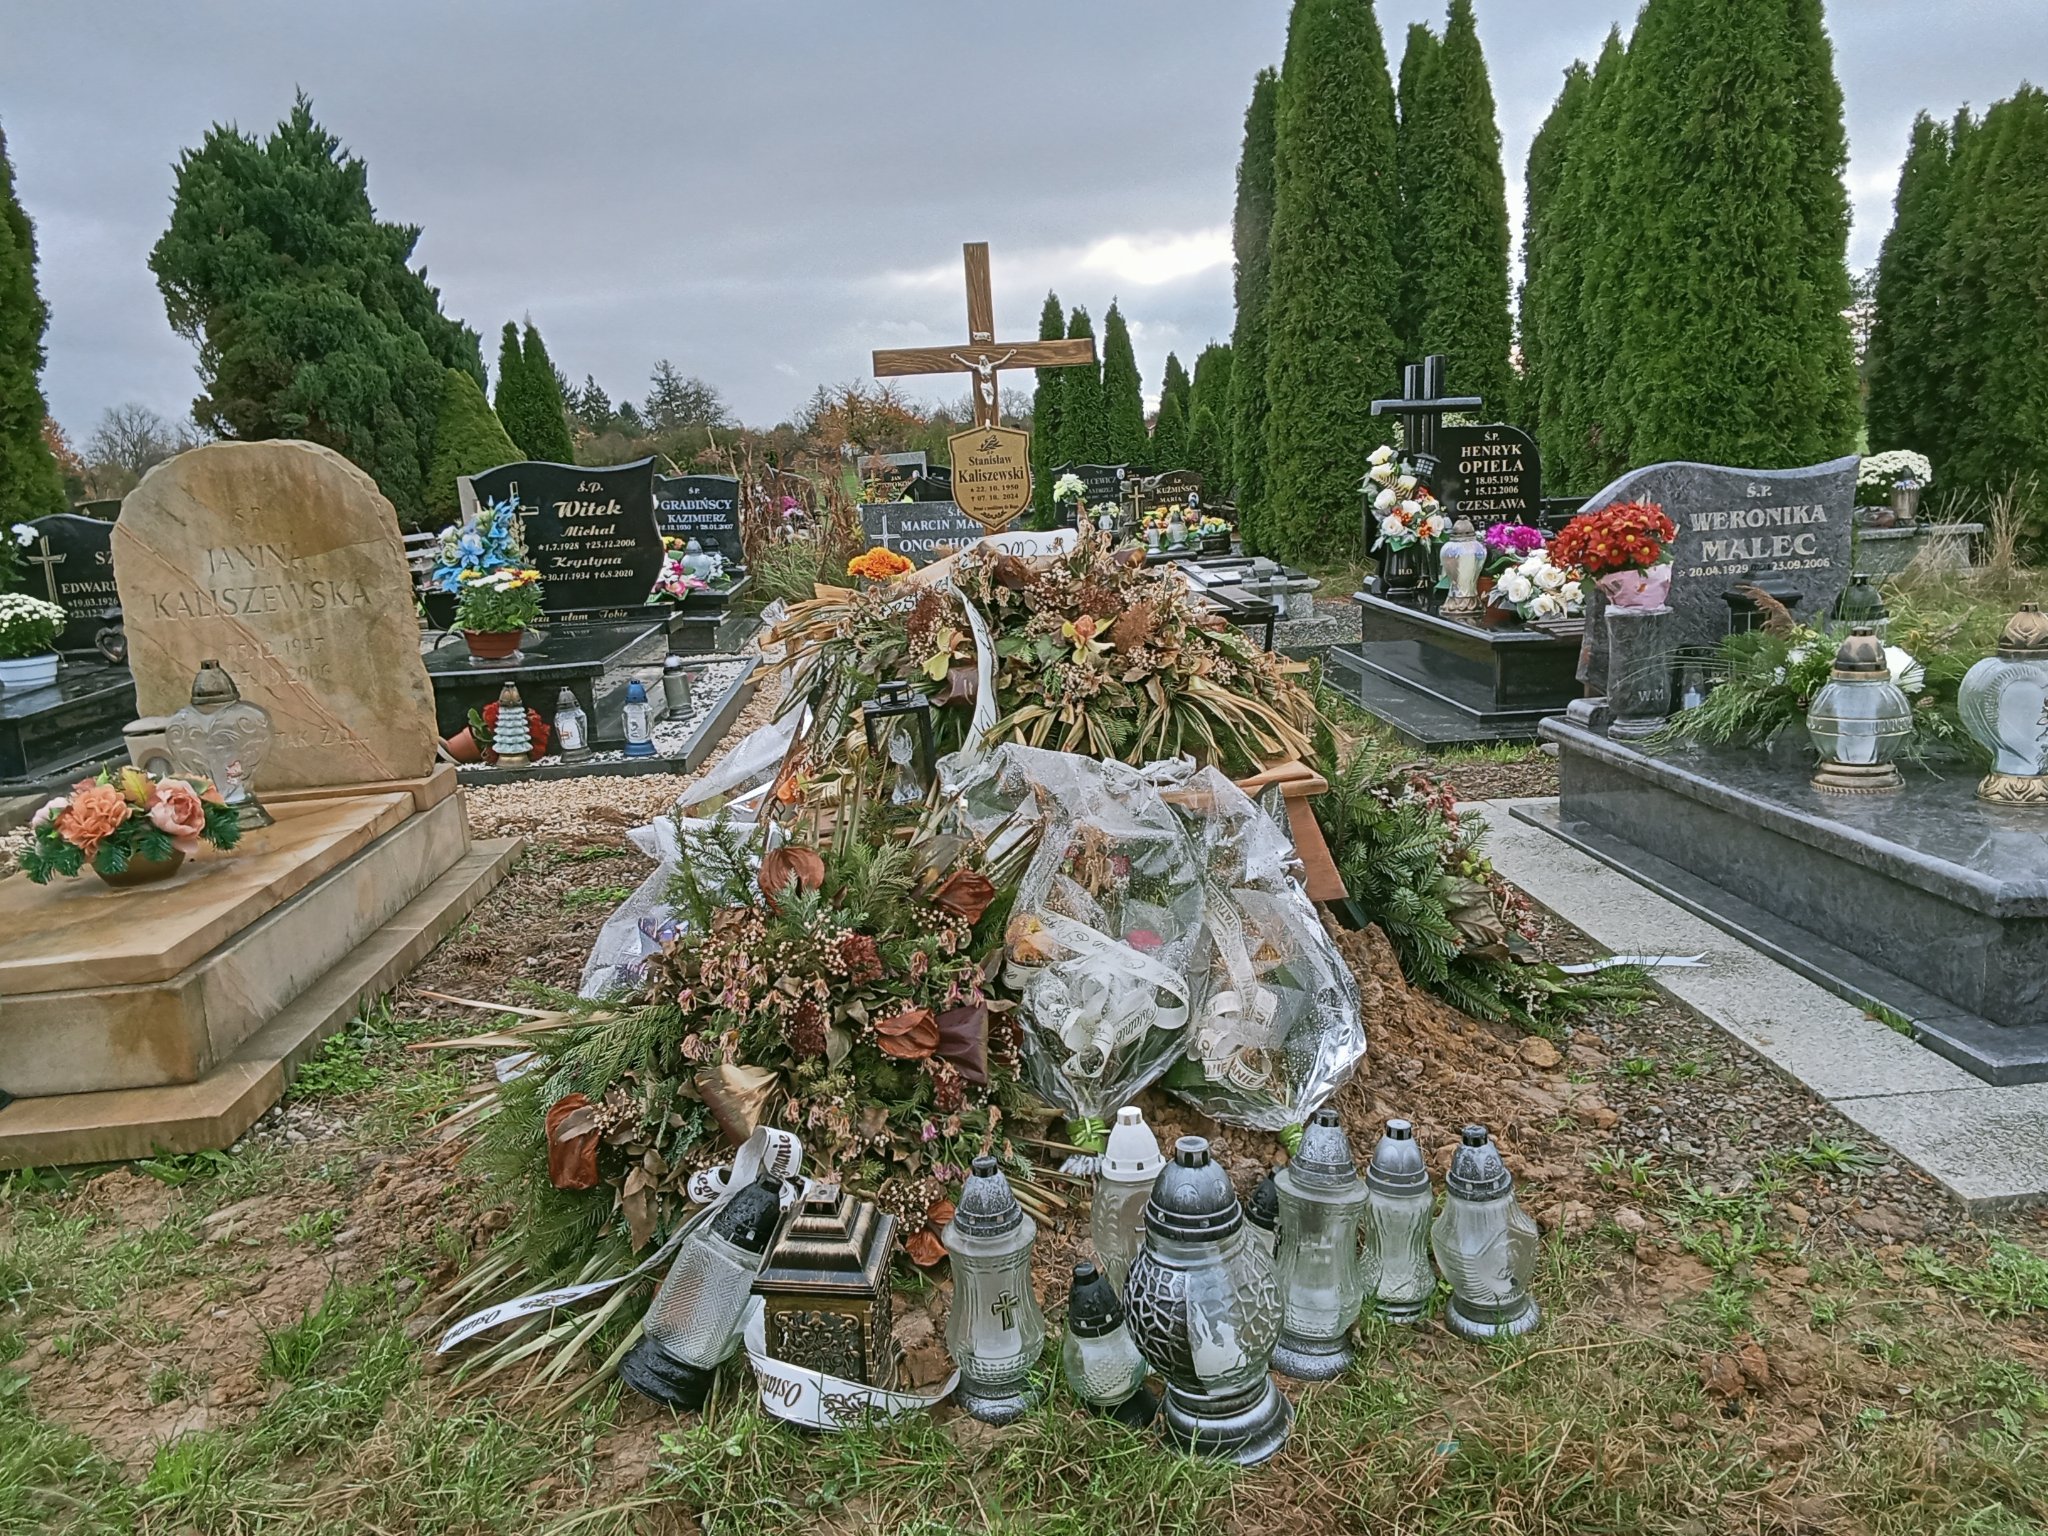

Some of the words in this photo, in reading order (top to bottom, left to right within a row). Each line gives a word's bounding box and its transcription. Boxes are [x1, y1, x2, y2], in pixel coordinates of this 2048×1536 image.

[1461, 444, 1522, 457] HENRYK
[1459, 459, 1524, 474] OPIELA
[958, 466, 1024, 483] Kaliszewski
[1475, 476, 1519, 485] 18.05.1936
[1475, 487, 1519, 495] 15.12.2006
[552, 499, 623, 518] Witek
[661, 497, 733, 510] GRABIŃSCY
[667, 513, 726, 523] KAZIMIERZ
[901, 519, 950, 531] MARCIN
[1689, 504, 1828, 532] WERONIKA
[1700, 533, 1818, 563] MALEC
[207, 542, 303, 575] JANINA
[550, 556, 622, 569] Krystyna
[1689, 564, 1749, 577] 20.04.1929
[1772, 558, 1831, 571] 23.09.2006
[152, 578, 372, 620] KALISZEWSKA
